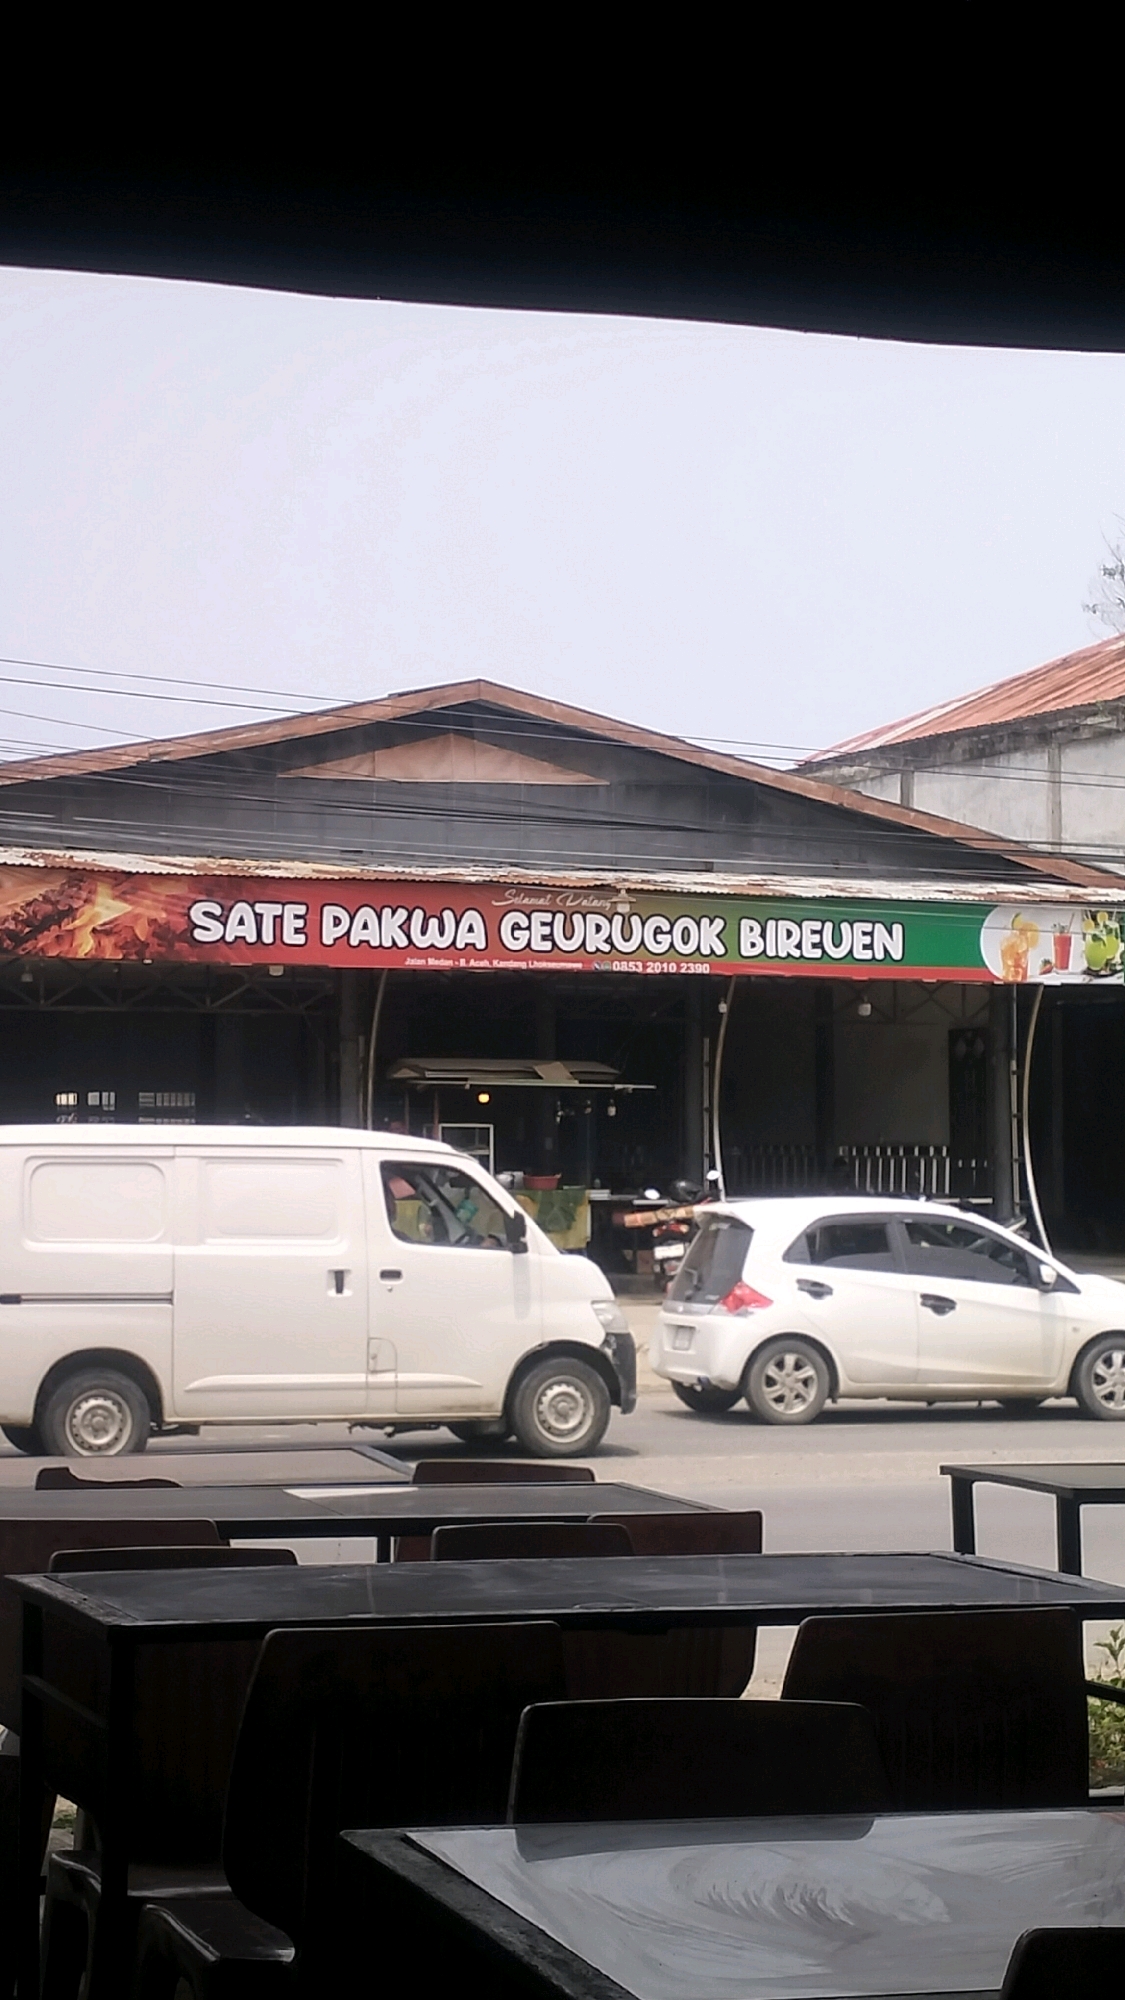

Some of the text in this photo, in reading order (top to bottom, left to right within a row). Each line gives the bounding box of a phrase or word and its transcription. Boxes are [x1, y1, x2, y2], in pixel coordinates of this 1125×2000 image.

[491, 888, 552, 907] Selamat
[188, 900, 905, 961] SATE PAKWA GEURUGOK BIREUEN
[404, 957, 427, 966] Jalan
[612, 961, 710, 975] 0853 2010 2390
